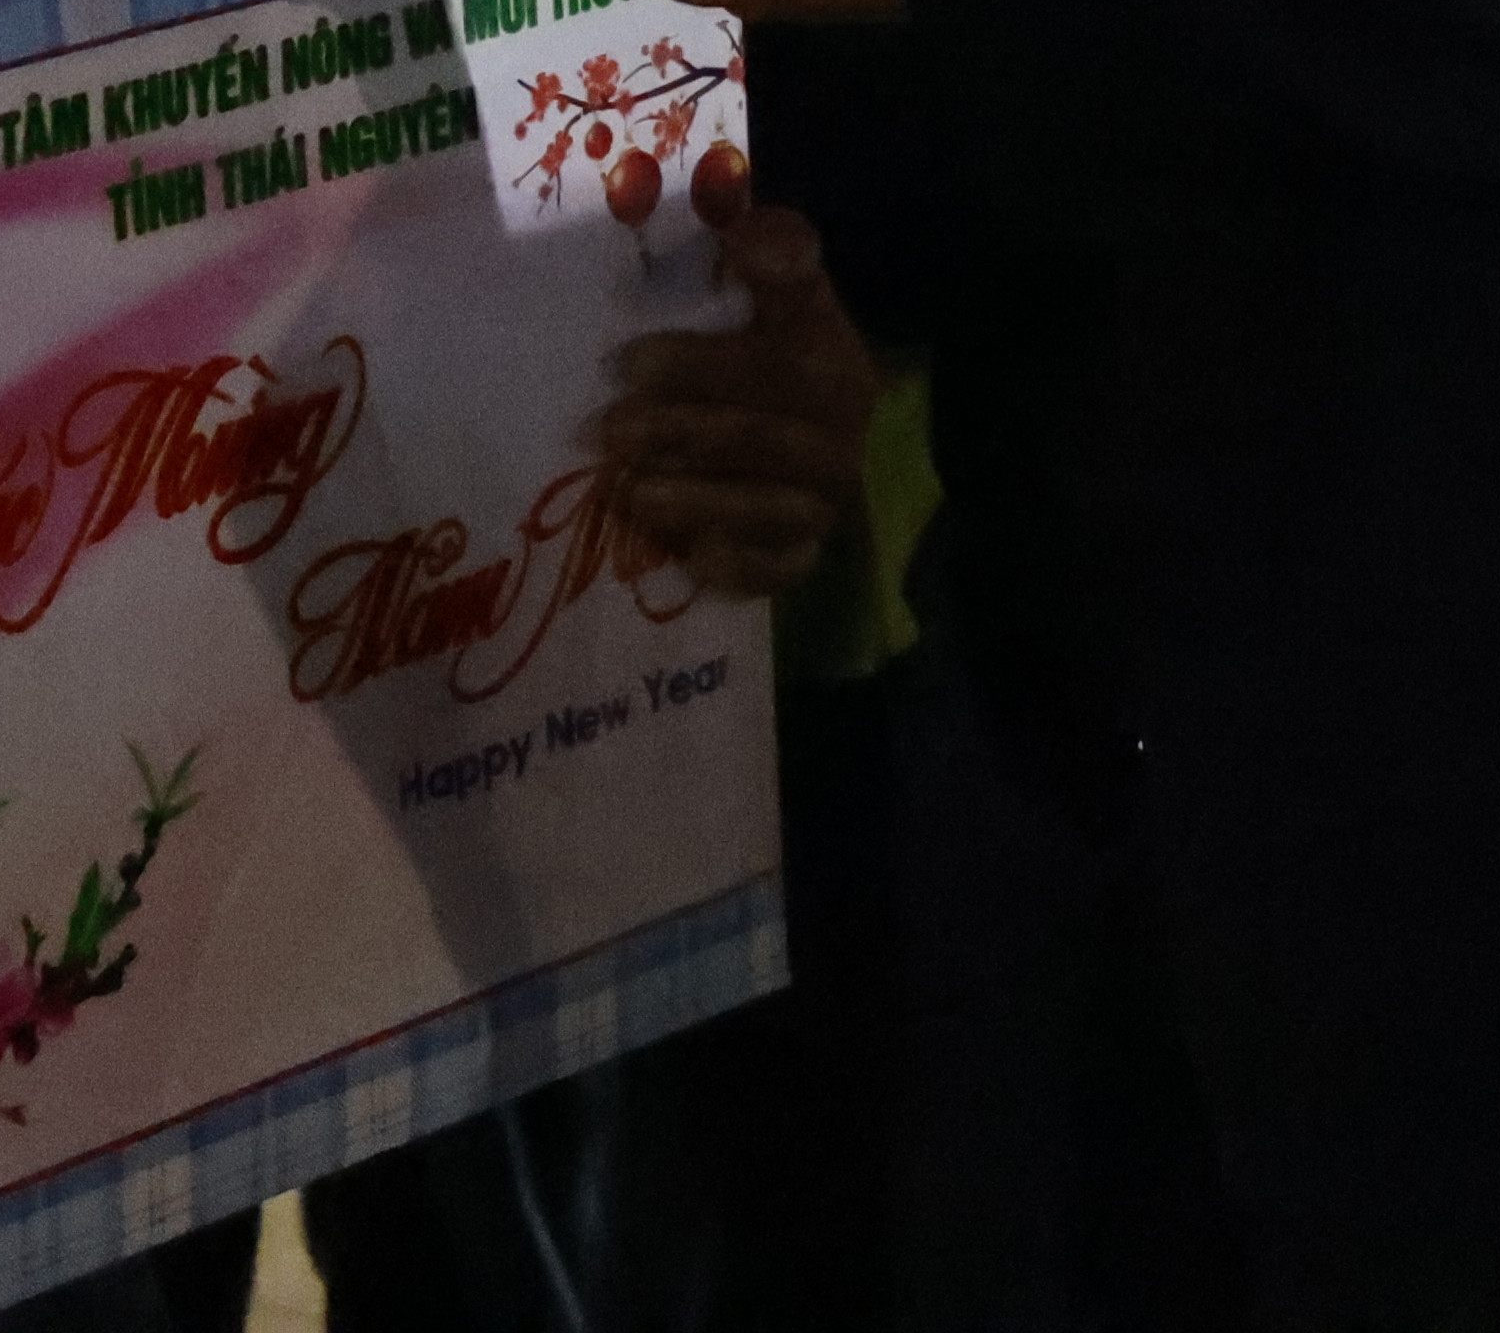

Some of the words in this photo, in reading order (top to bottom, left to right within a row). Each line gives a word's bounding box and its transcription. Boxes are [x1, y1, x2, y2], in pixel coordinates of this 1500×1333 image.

[102, 33, 270, 143] KHUYẾN
[281, 16, 394, 94] NÔNG
[107, 158, 207, 241] TỈNH
[215, 125, 309, 209] THÁI
[319, 82, 481, 182] NGUYÊN
[399, 731, 532, 811] Happy
[545, 694, 632, 752] New
[643, 649, 731, 714] Year
